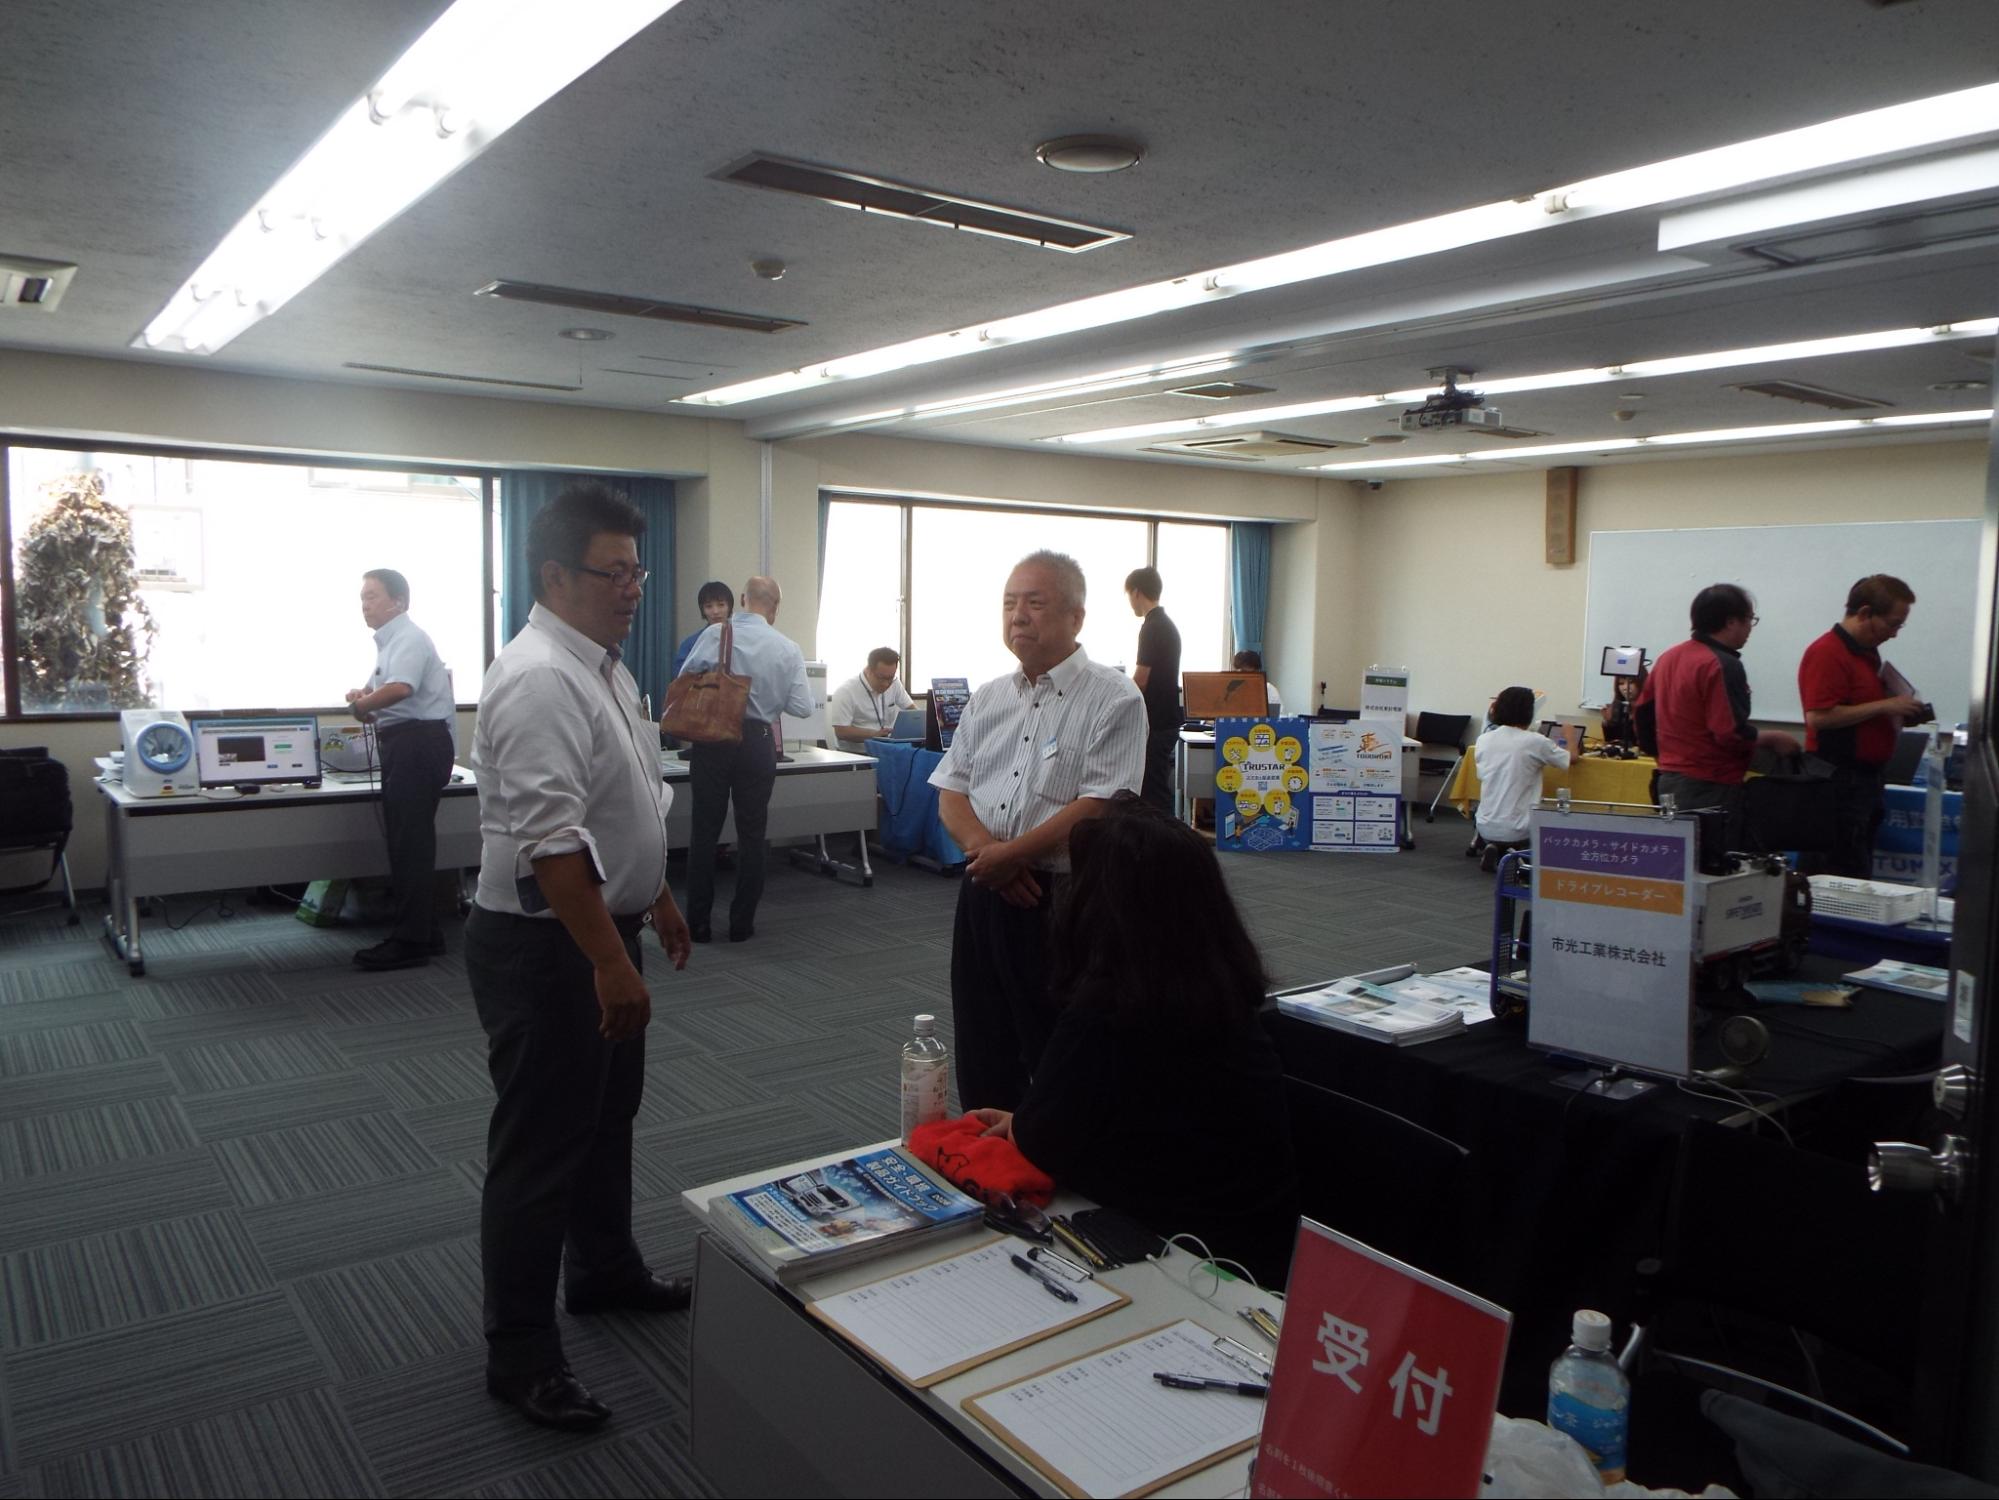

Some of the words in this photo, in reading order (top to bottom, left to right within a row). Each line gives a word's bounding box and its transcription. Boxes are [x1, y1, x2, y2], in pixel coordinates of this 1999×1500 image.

[1243, 761, 1285, 771] TRUSTAR
[1580, 850, 1639, 865] 全方位カメラ
[1556, 879, 1665, 902] ドライブレコーダー
[1552, 936, 1666, 968] 市光工業株式会社
[1312, 1311, 1453, 1437] 受付
